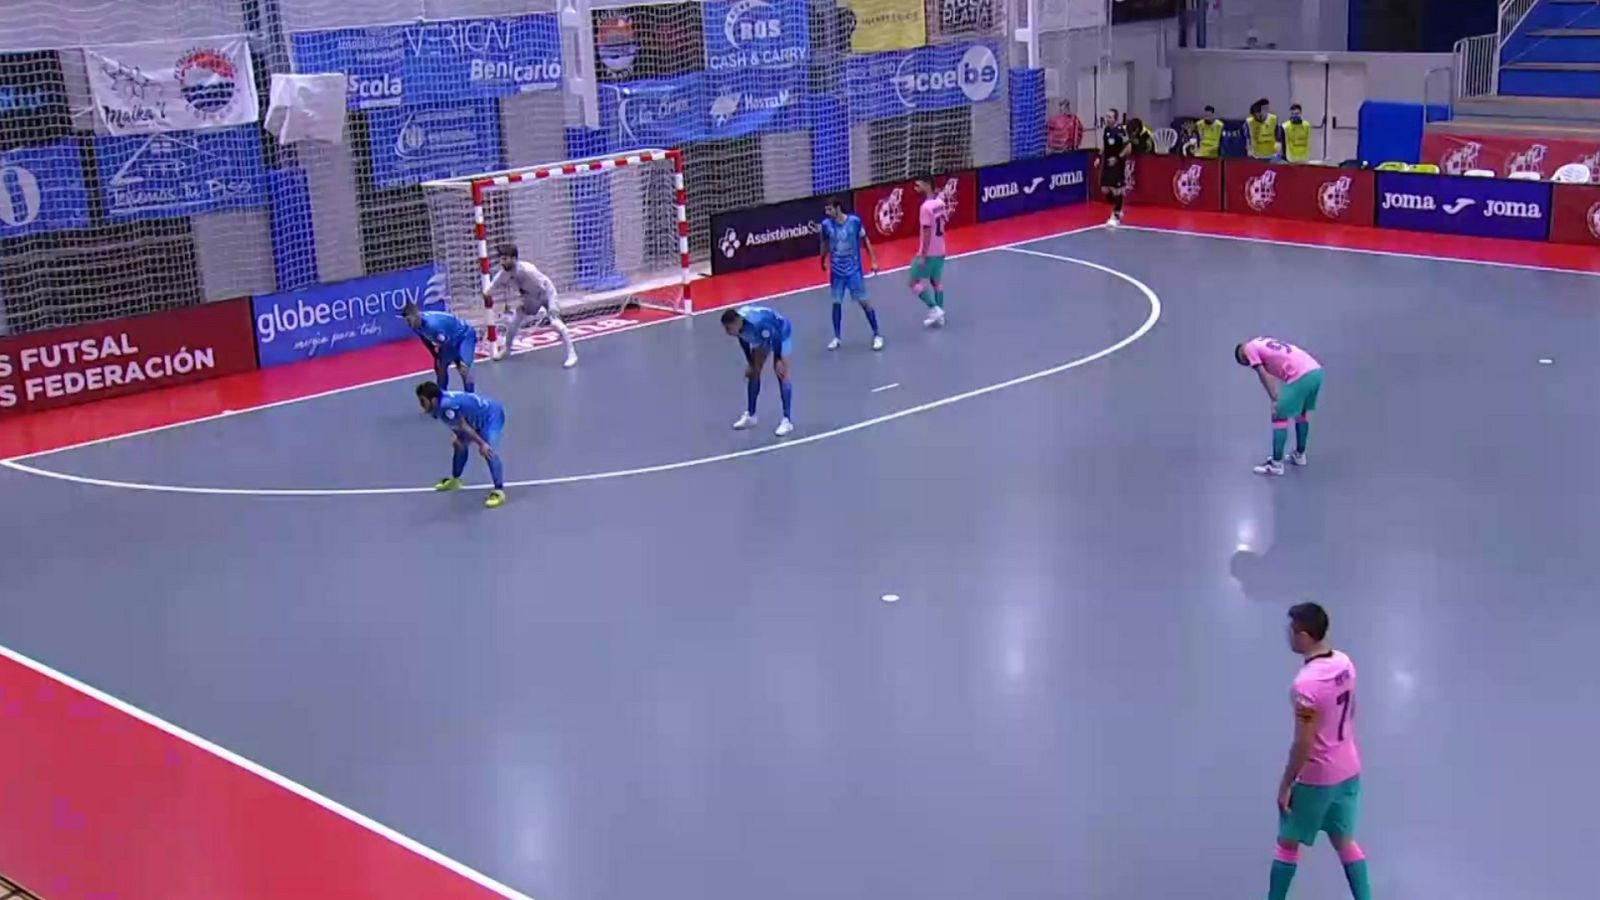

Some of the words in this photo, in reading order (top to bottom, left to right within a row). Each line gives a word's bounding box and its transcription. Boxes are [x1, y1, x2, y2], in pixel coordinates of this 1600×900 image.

[740, 19, 781, 40] ROS
[471, 53, 561, 82] Benicarló
[709, 51, 747, 69] CASH
[751, 50, 760, 66] &
[763, 47, 806, 63] CARRY
[20, 333, 139, 372] FUTSAL
[24, 346, 215, 401] FEDERACIÓN
[1336, 690, 1350, 742] 7
